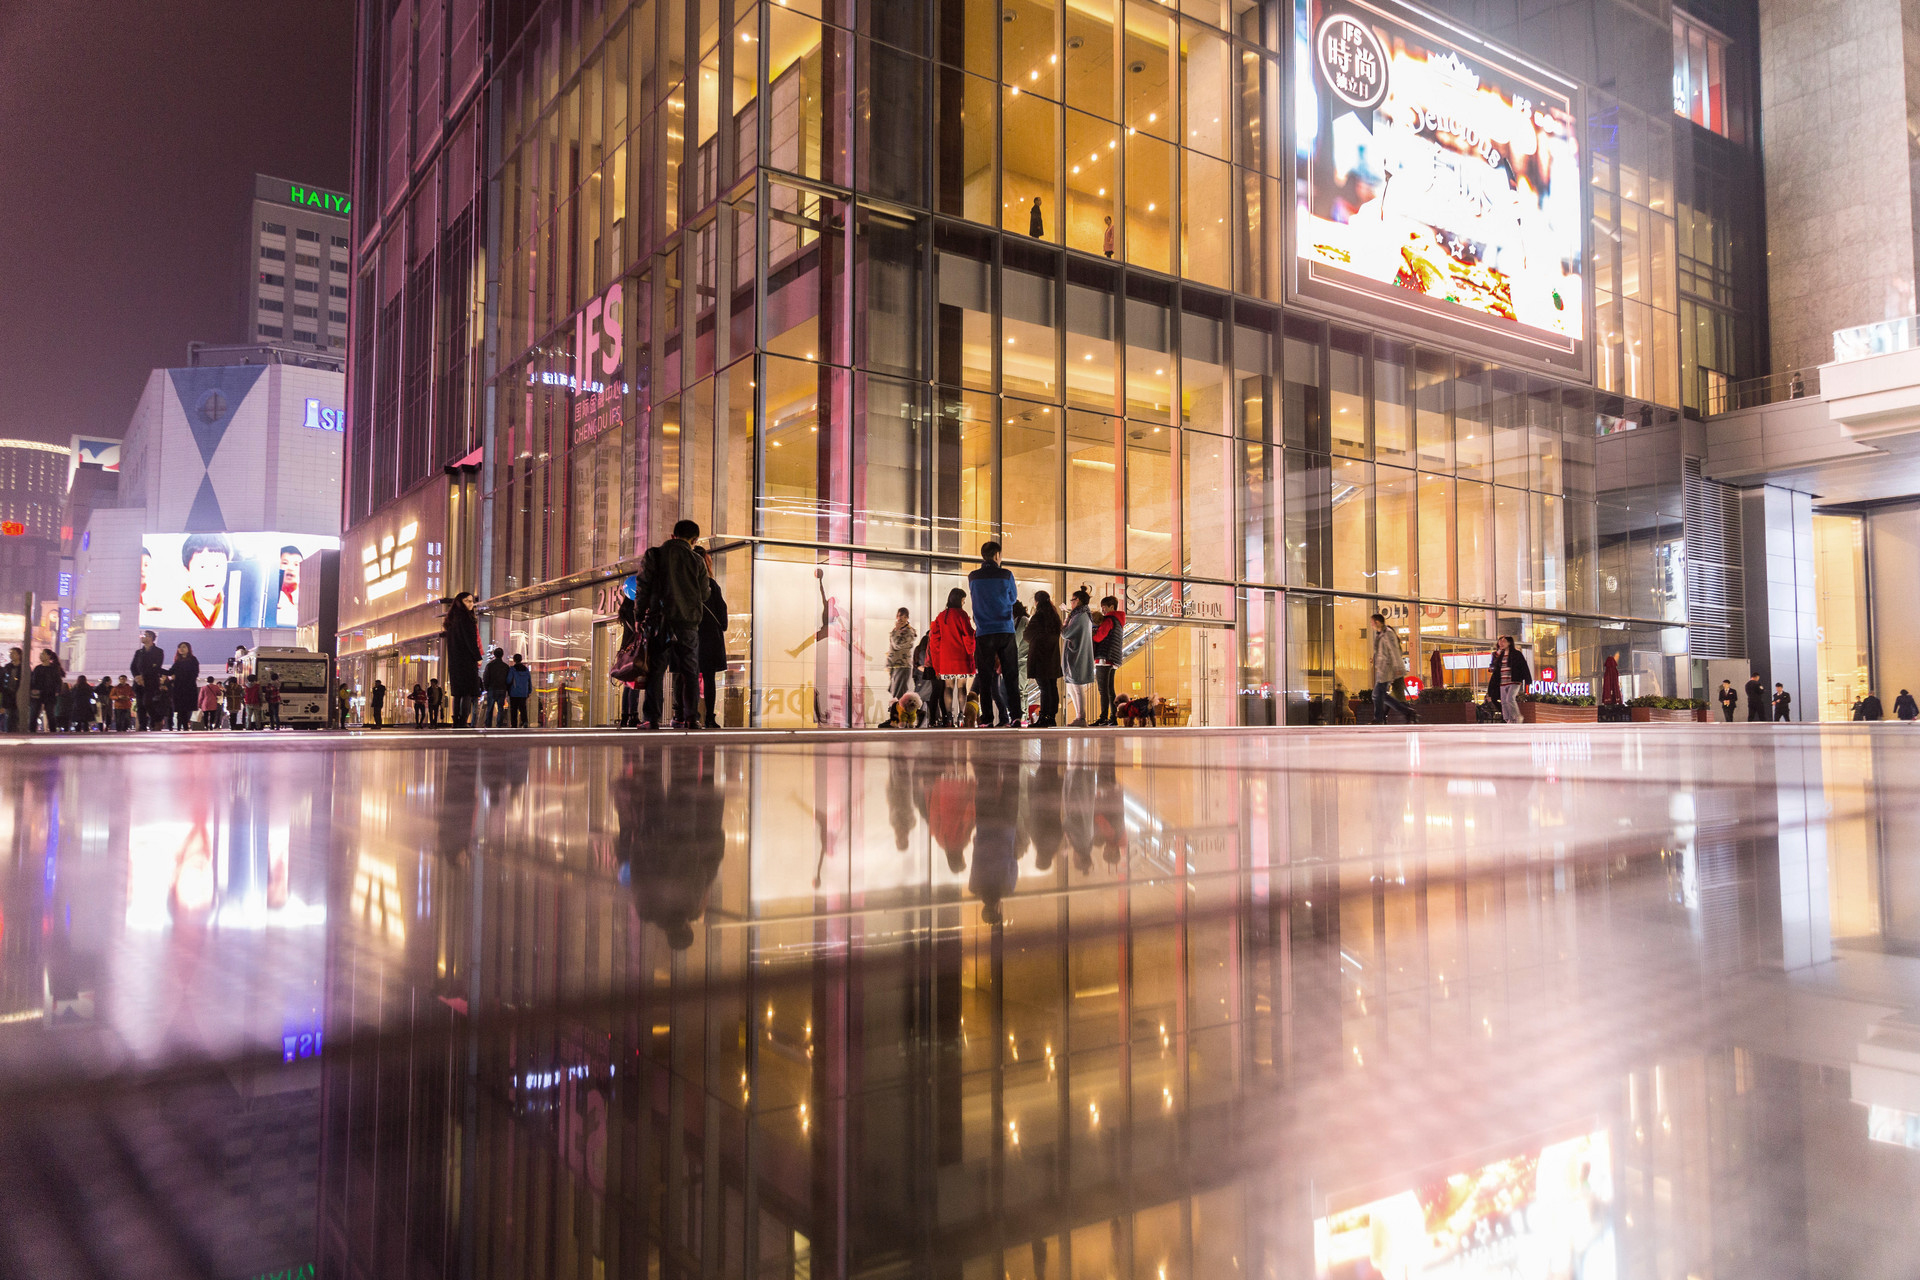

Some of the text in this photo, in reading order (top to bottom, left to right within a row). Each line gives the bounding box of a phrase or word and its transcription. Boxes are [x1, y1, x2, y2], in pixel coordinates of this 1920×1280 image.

[1342, 21, 1363, 46] IFS
[1328, 35, 1376, 85] 時尚
[575, 283, 622, 397] IFS
[574, 405, 621, 445] CHENGDU IFS
[597, 584, 624, 615] 2 IFS
[1105, 582, 1140, 612] IFS
[1559, 682, 1590, 697] COFFEE
